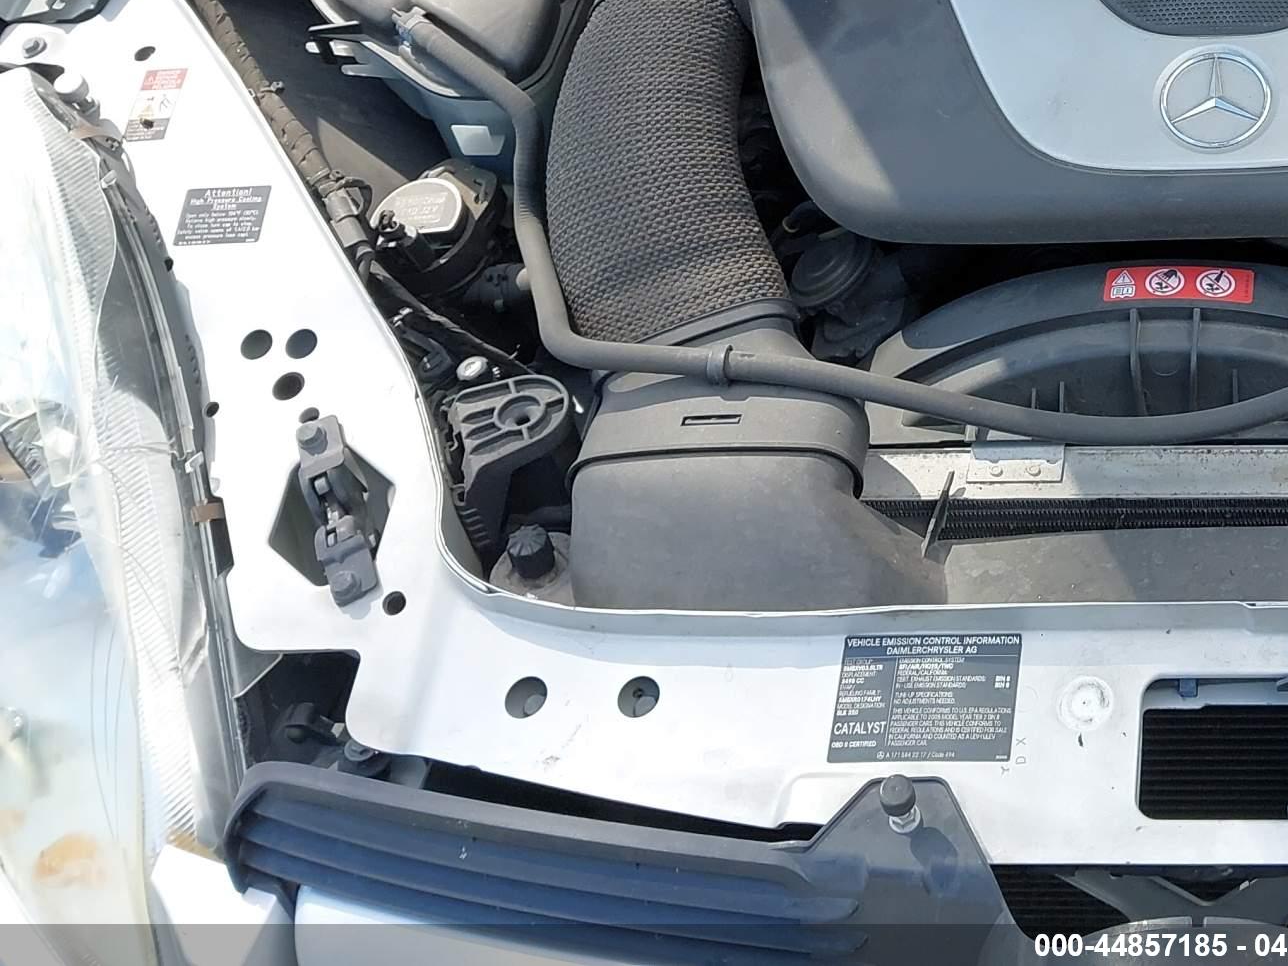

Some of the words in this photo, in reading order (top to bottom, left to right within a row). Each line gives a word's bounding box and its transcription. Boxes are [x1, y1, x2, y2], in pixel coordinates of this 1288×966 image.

[204, 188, 252, 198] Attention!
[847, 638, 881, 647] VEHICLE
[882, 637, 921, 646] EMISSION
[922, 637, 961, 645] CONTROL
[963, 636, 1020, 645] INFORMATION
[886, 646, 964, 655] DAIMLERCHRYSLER
[965, 646, 978, 654] AG
[833, 721, 886, 734] CATALYST
[850, 740, 877, 748] CERTIFIED
